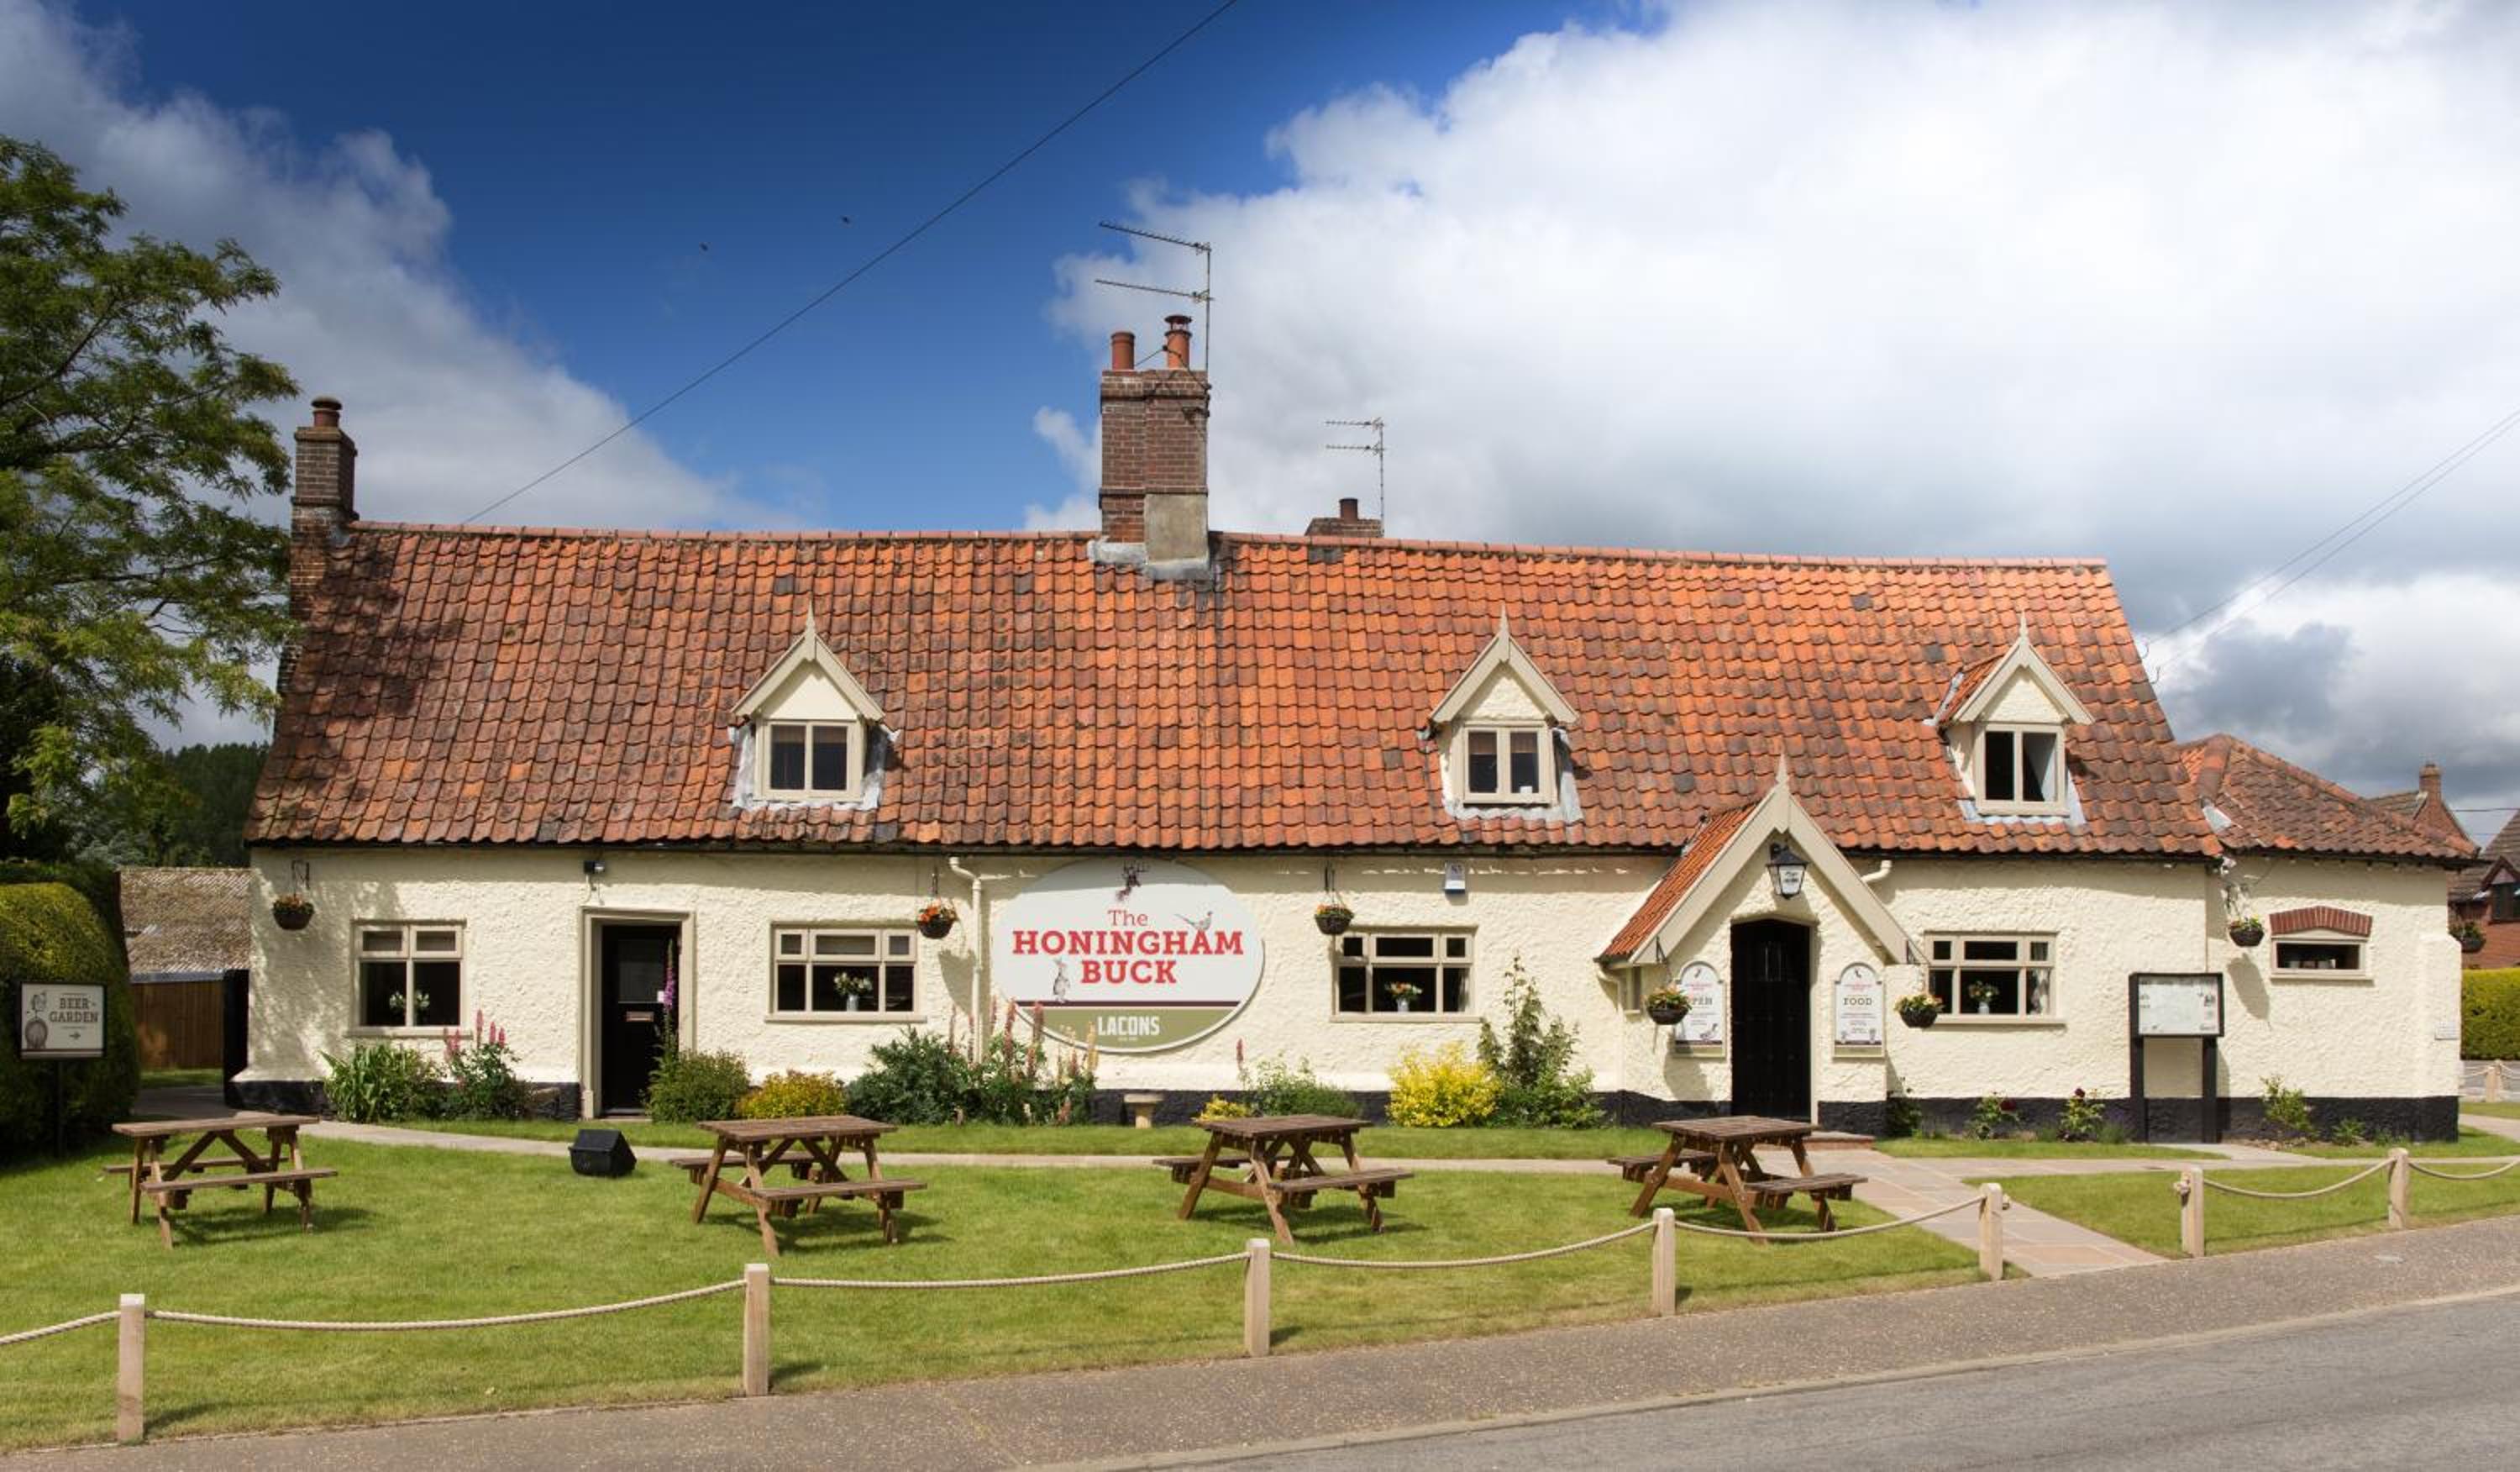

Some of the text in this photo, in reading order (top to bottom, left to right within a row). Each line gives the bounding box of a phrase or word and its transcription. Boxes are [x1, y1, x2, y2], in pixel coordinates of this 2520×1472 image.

[1108, 910, 1148, 927] The
[1012, 930, 1243, 954] HONINGHAM
[1080, 959, 1177, 984] BUCK
[59, 998, 89, 1009] BEER
[50, 1011, 98, 1023] GARDEN
[1098, 1016, 1160, 1036] LACONS
